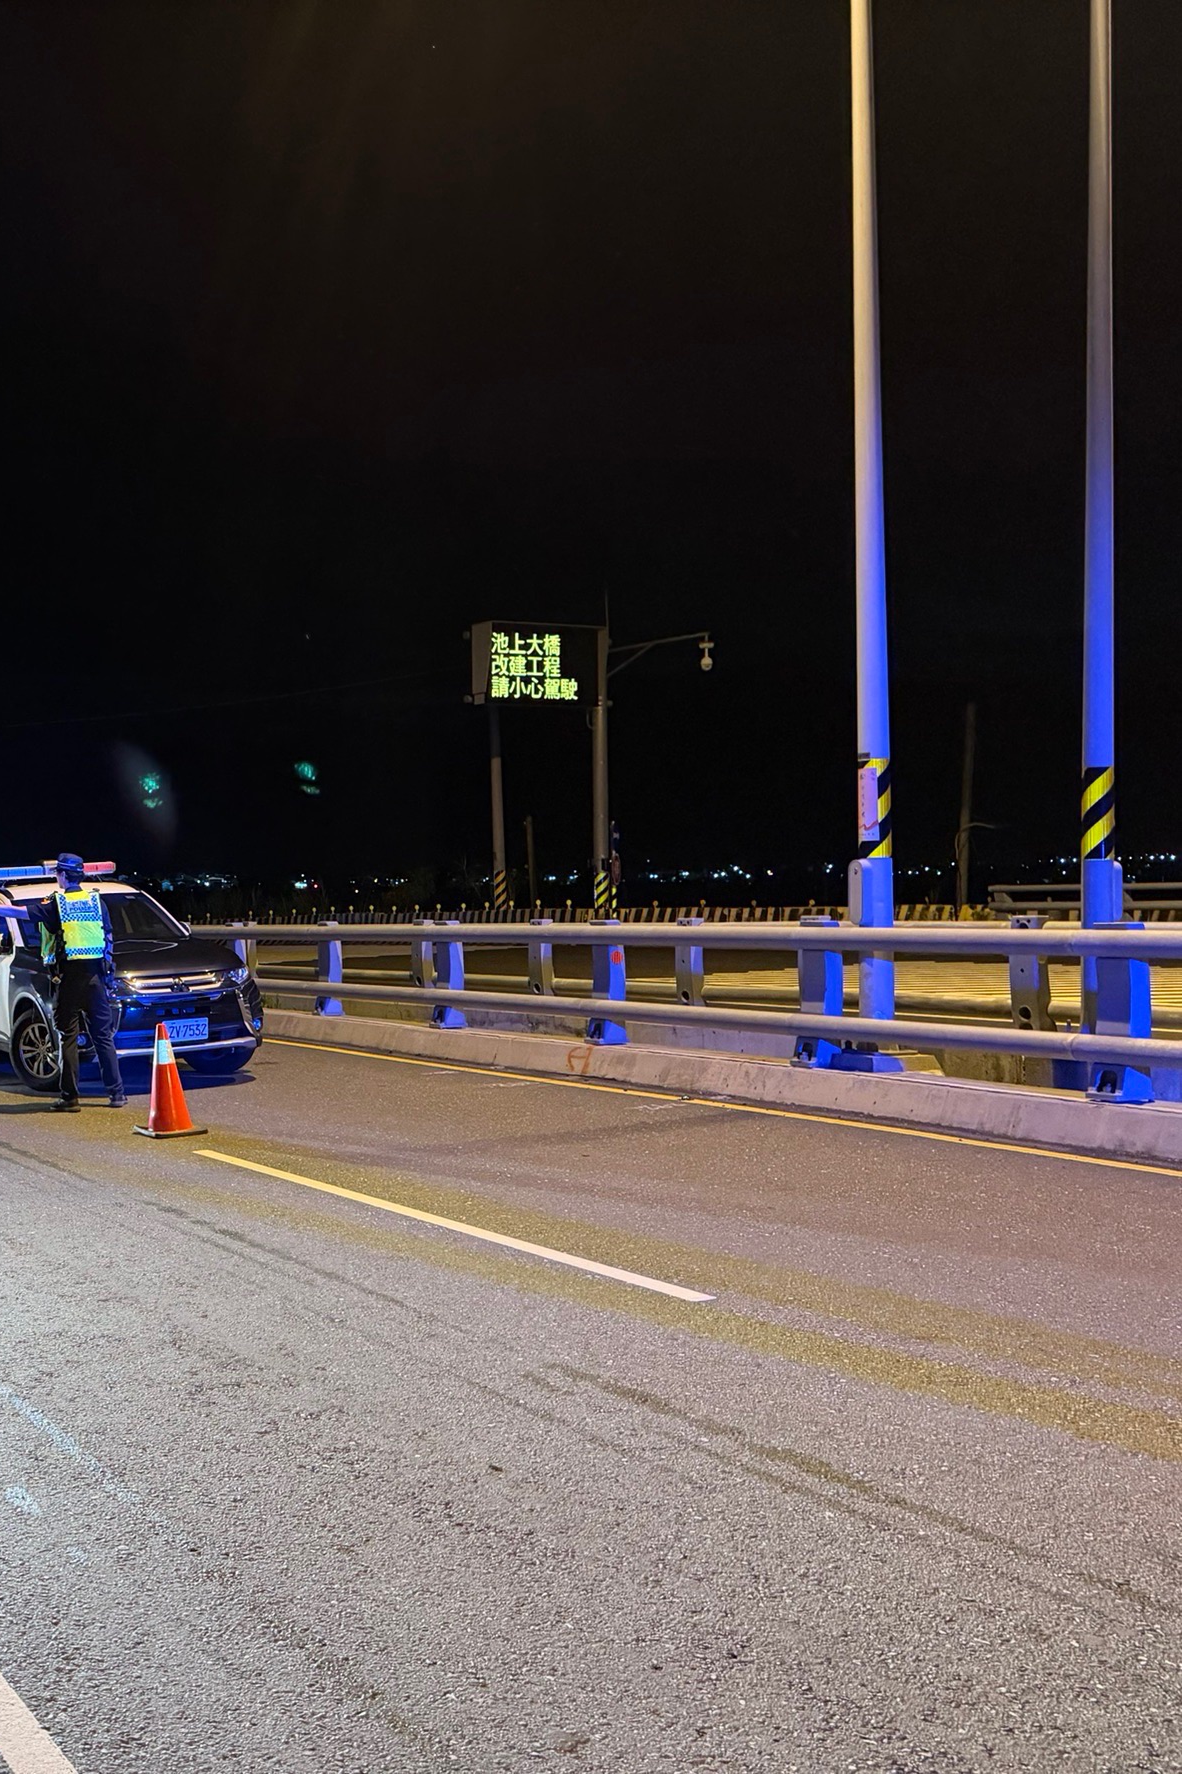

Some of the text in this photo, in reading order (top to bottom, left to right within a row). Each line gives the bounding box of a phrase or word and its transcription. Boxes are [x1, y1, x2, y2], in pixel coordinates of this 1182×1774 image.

[491, 632, 561, 656] 池上大橋
[491, 654, 561, 677] 改建工程
[491, 676, 578, 700] 請小心駕駛
[168, 1023, 207, 1039] ZV-7532
